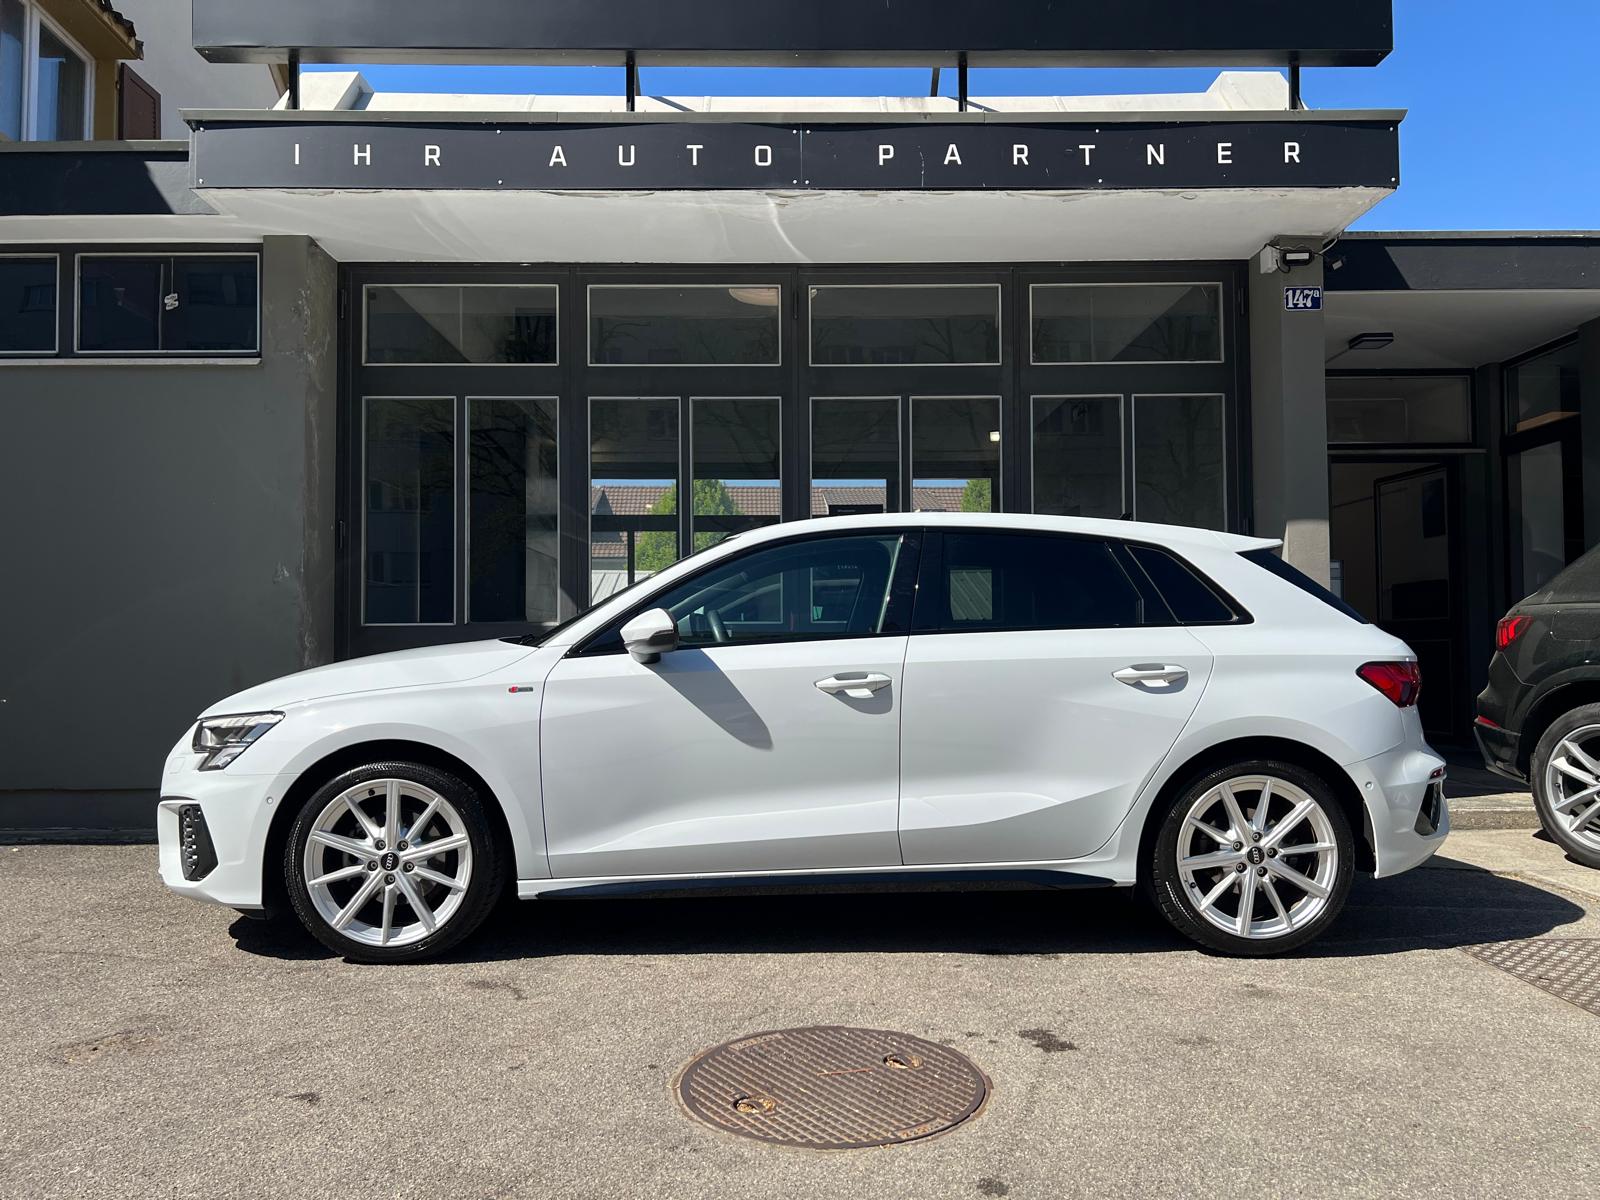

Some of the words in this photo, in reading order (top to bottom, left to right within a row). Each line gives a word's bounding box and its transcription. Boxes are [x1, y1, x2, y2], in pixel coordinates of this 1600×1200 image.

[294, 143, 441, 167] IHR
[548, 144, 773, 168] AUTO
[878, 141, 1302, 167] PARTNER
